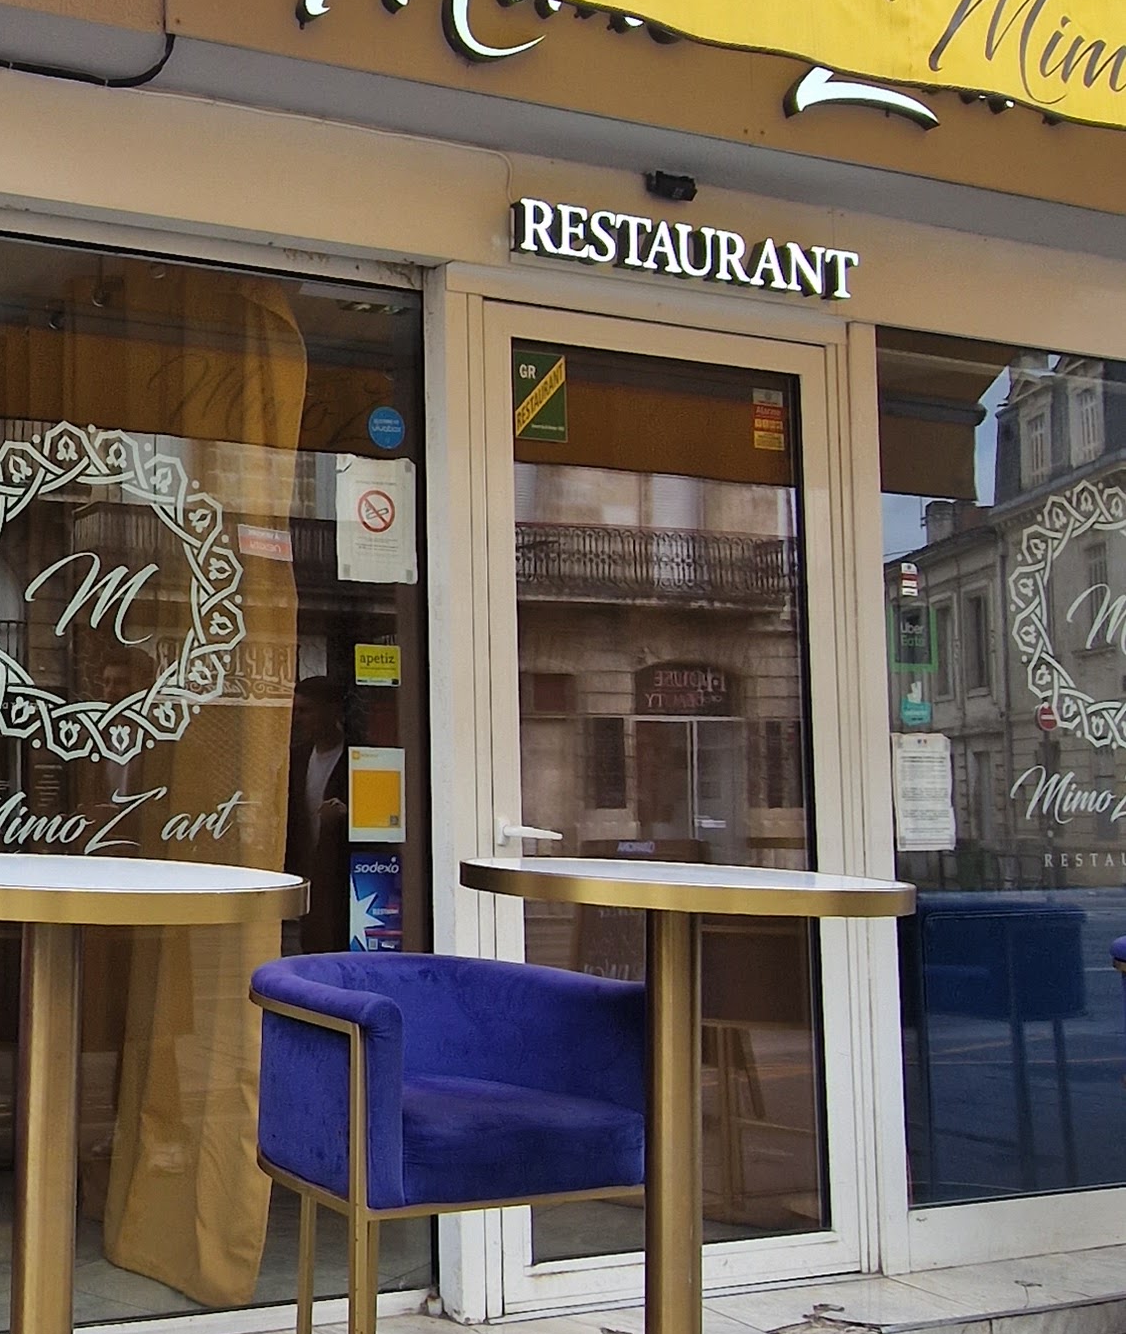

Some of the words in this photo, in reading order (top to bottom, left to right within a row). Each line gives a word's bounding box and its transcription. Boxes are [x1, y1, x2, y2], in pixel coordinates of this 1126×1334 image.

[520, 197, 860, 299] RESTAURANT
[519, 363, 536, 379] GR
[516, 361, 564, 433] RESTAURANT
[24, 551, 160, 645] M
[900, 621, 924, 634] Uber
[359, 652, 396, 666] apetiz
[354, 856, 400, 875] sodexo
